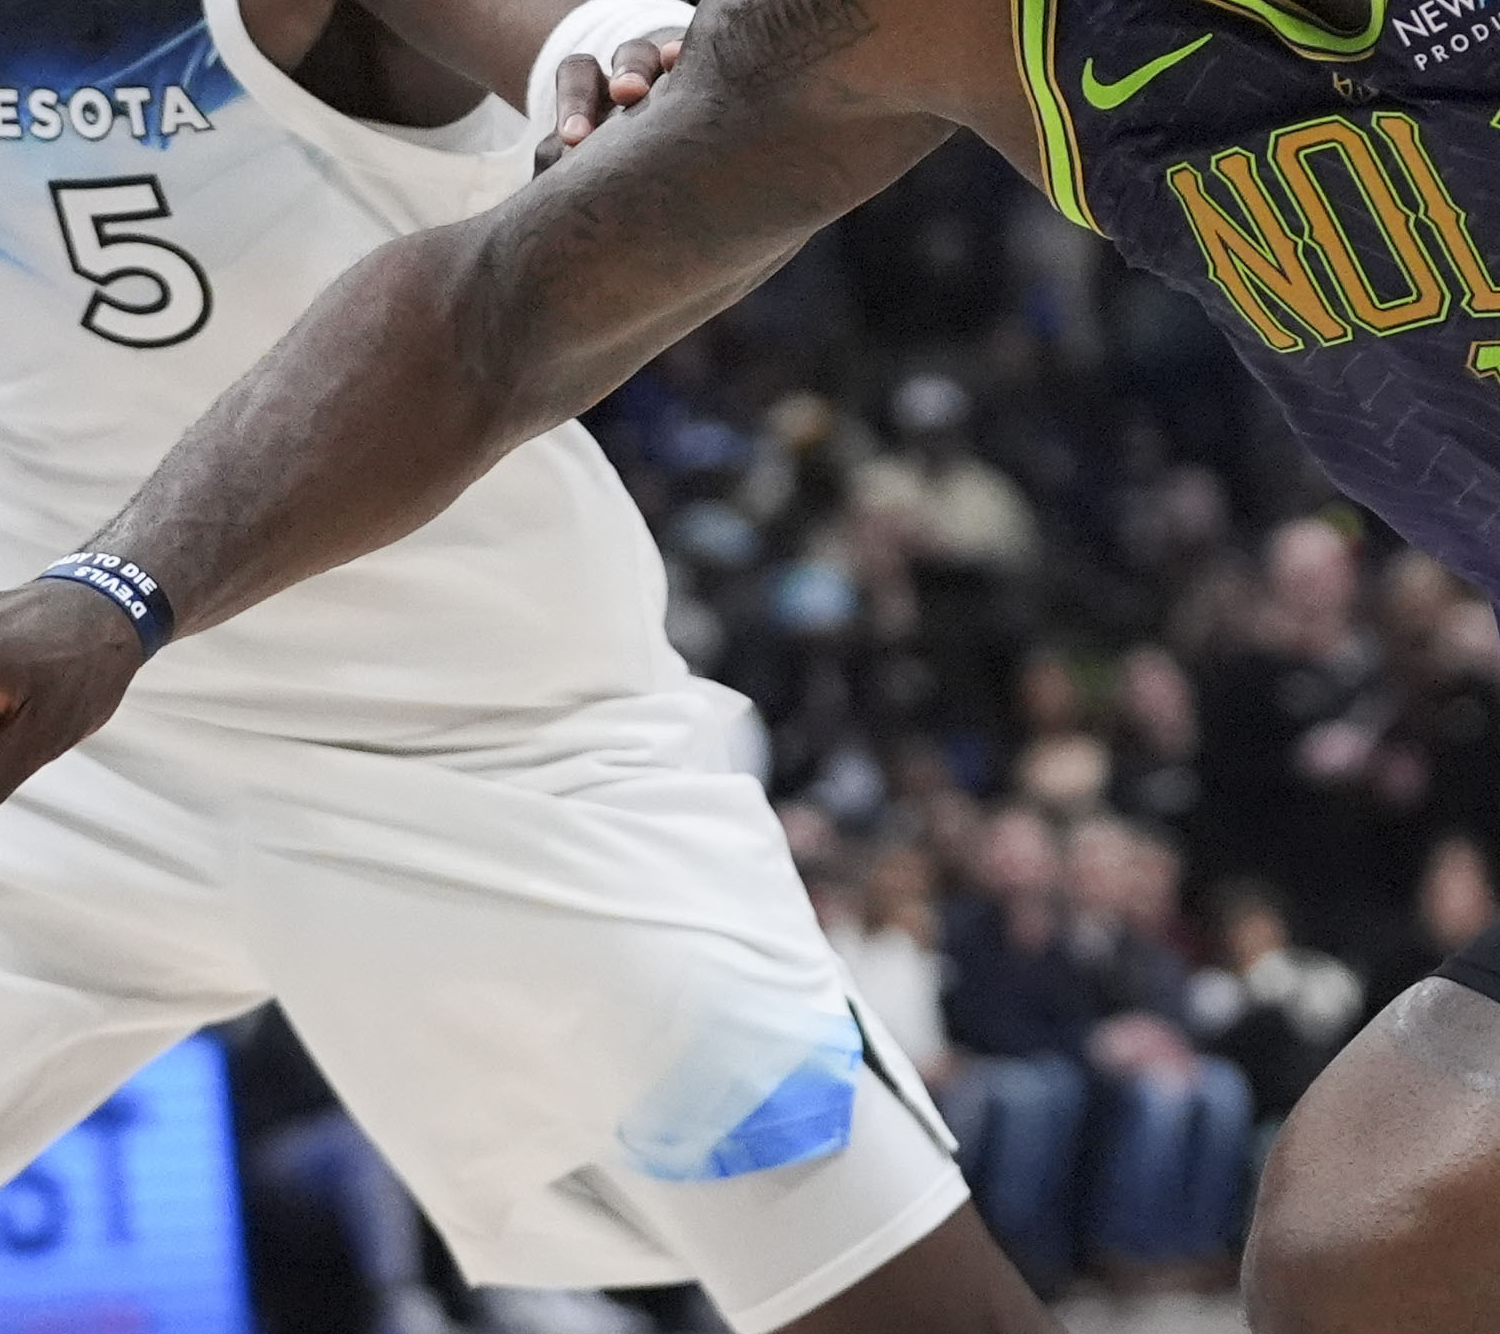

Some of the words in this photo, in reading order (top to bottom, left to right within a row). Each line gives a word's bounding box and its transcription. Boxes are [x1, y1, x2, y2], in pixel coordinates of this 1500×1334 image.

[48, 174, 214, 348] 5
[92, 553, 121, 568] TO
[121, 563, 158, 596] DIE
